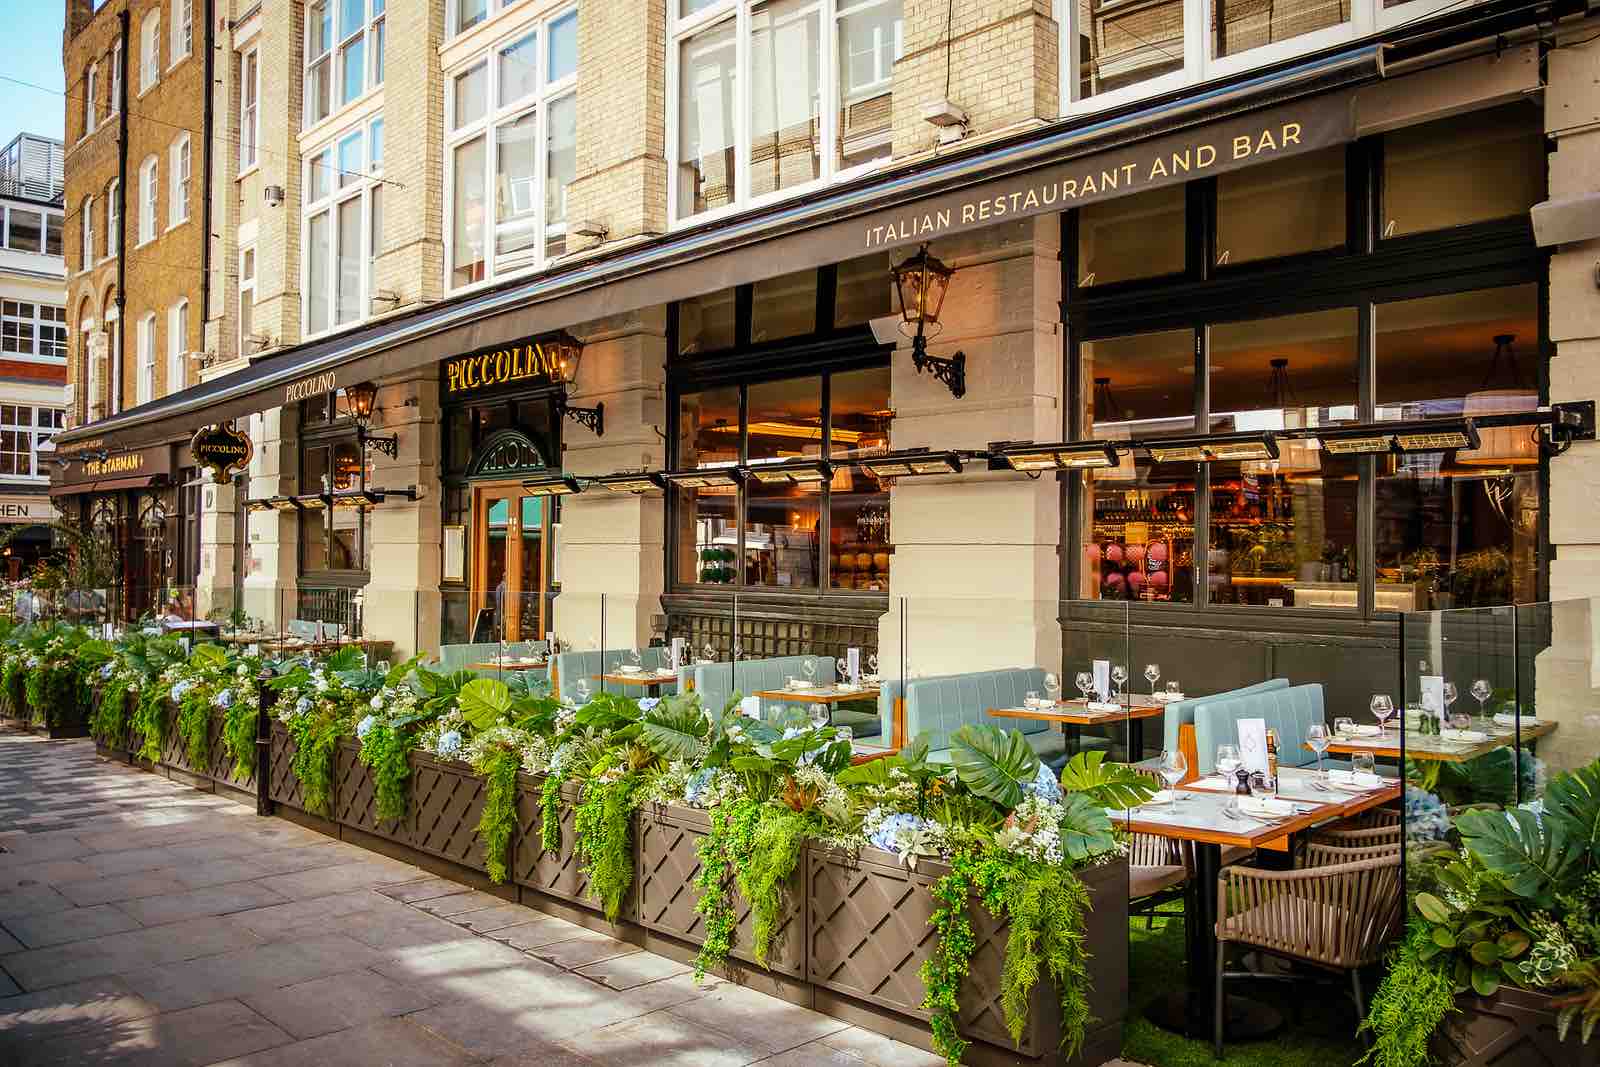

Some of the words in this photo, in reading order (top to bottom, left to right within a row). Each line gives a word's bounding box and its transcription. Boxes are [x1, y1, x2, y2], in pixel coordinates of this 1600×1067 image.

[865, 208, 951, 248] ITALIAN
[962, 163, 1138, 223] RESTAURANT
[1149, 142, 1217, 180] AND
[1232, 121, 1303, 157] BAR
[285, 371, 337, 402] PICCOLINO
[200, 444, 247, 454] PICCOLINO
[86, 461, 101, 476] THE
[102, 454, 139, 474] STARMAN
